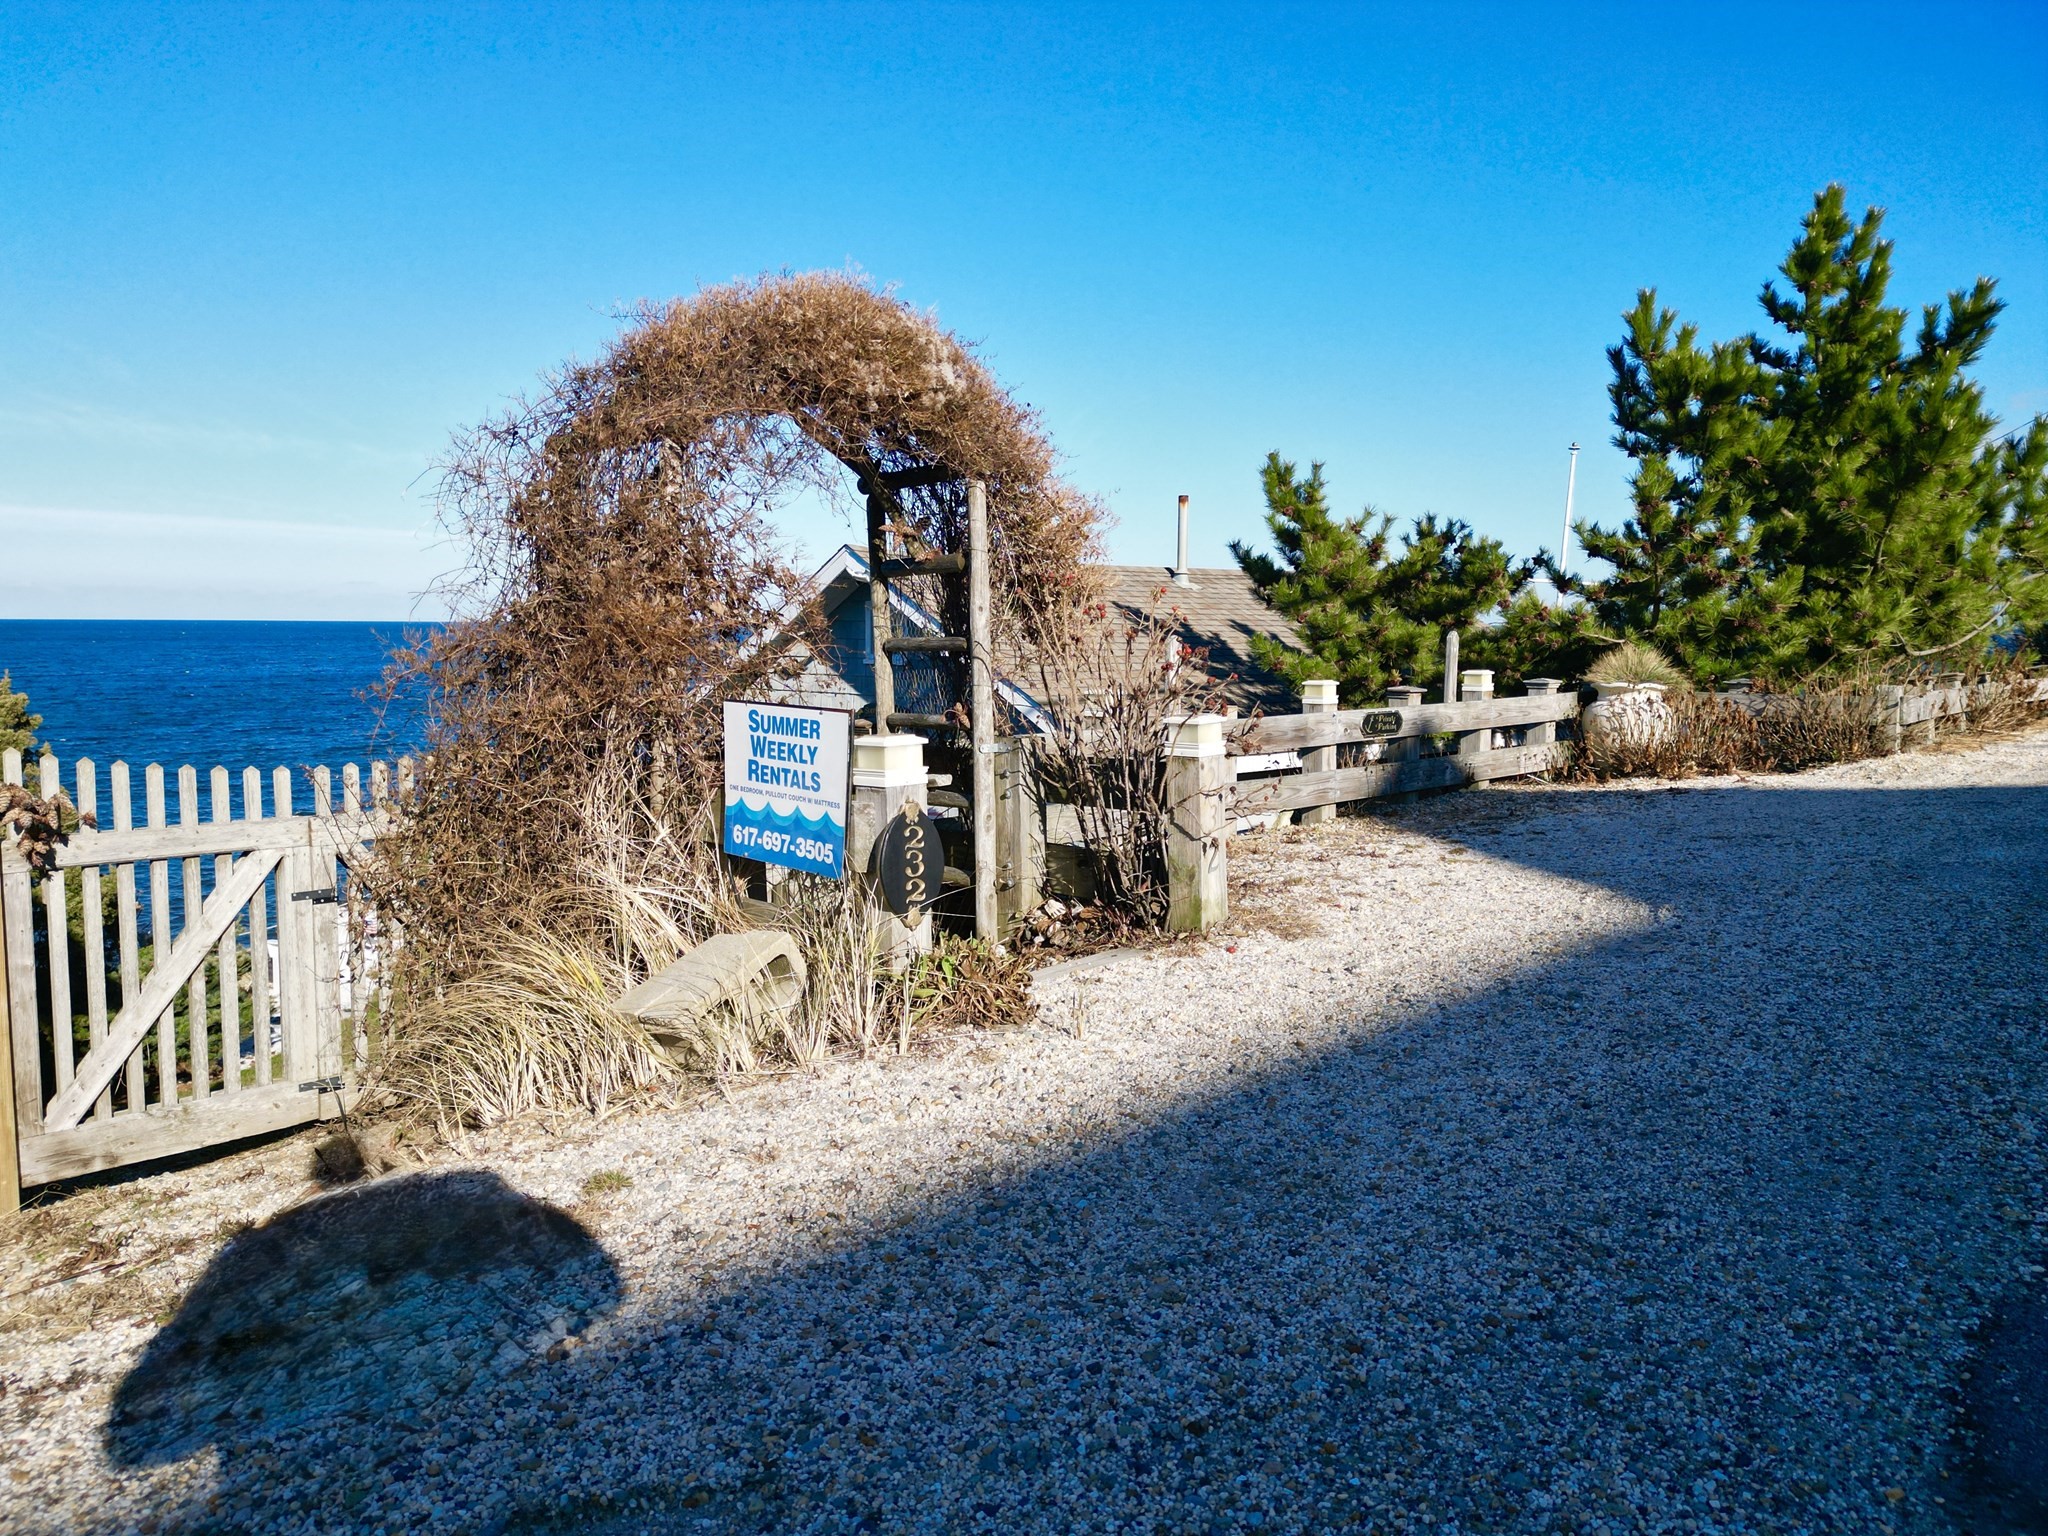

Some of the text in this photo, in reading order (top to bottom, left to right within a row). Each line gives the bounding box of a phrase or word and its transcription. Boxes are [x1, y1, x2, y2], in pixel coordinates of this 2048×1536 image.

[748, 709, 821, 740] SUMMER
[750, 734, 818, 765] WEEKLY
[747, 759, 821, 792] RENTALS
[765, 790, 787, 799] PULLOUT
[788, 794, 806, 803] COUCH
[814, 798, 841, 809] MATTRESS
[732, 824, 834, 864] 617-697-3505
[903, 826, 926, 904] 232
